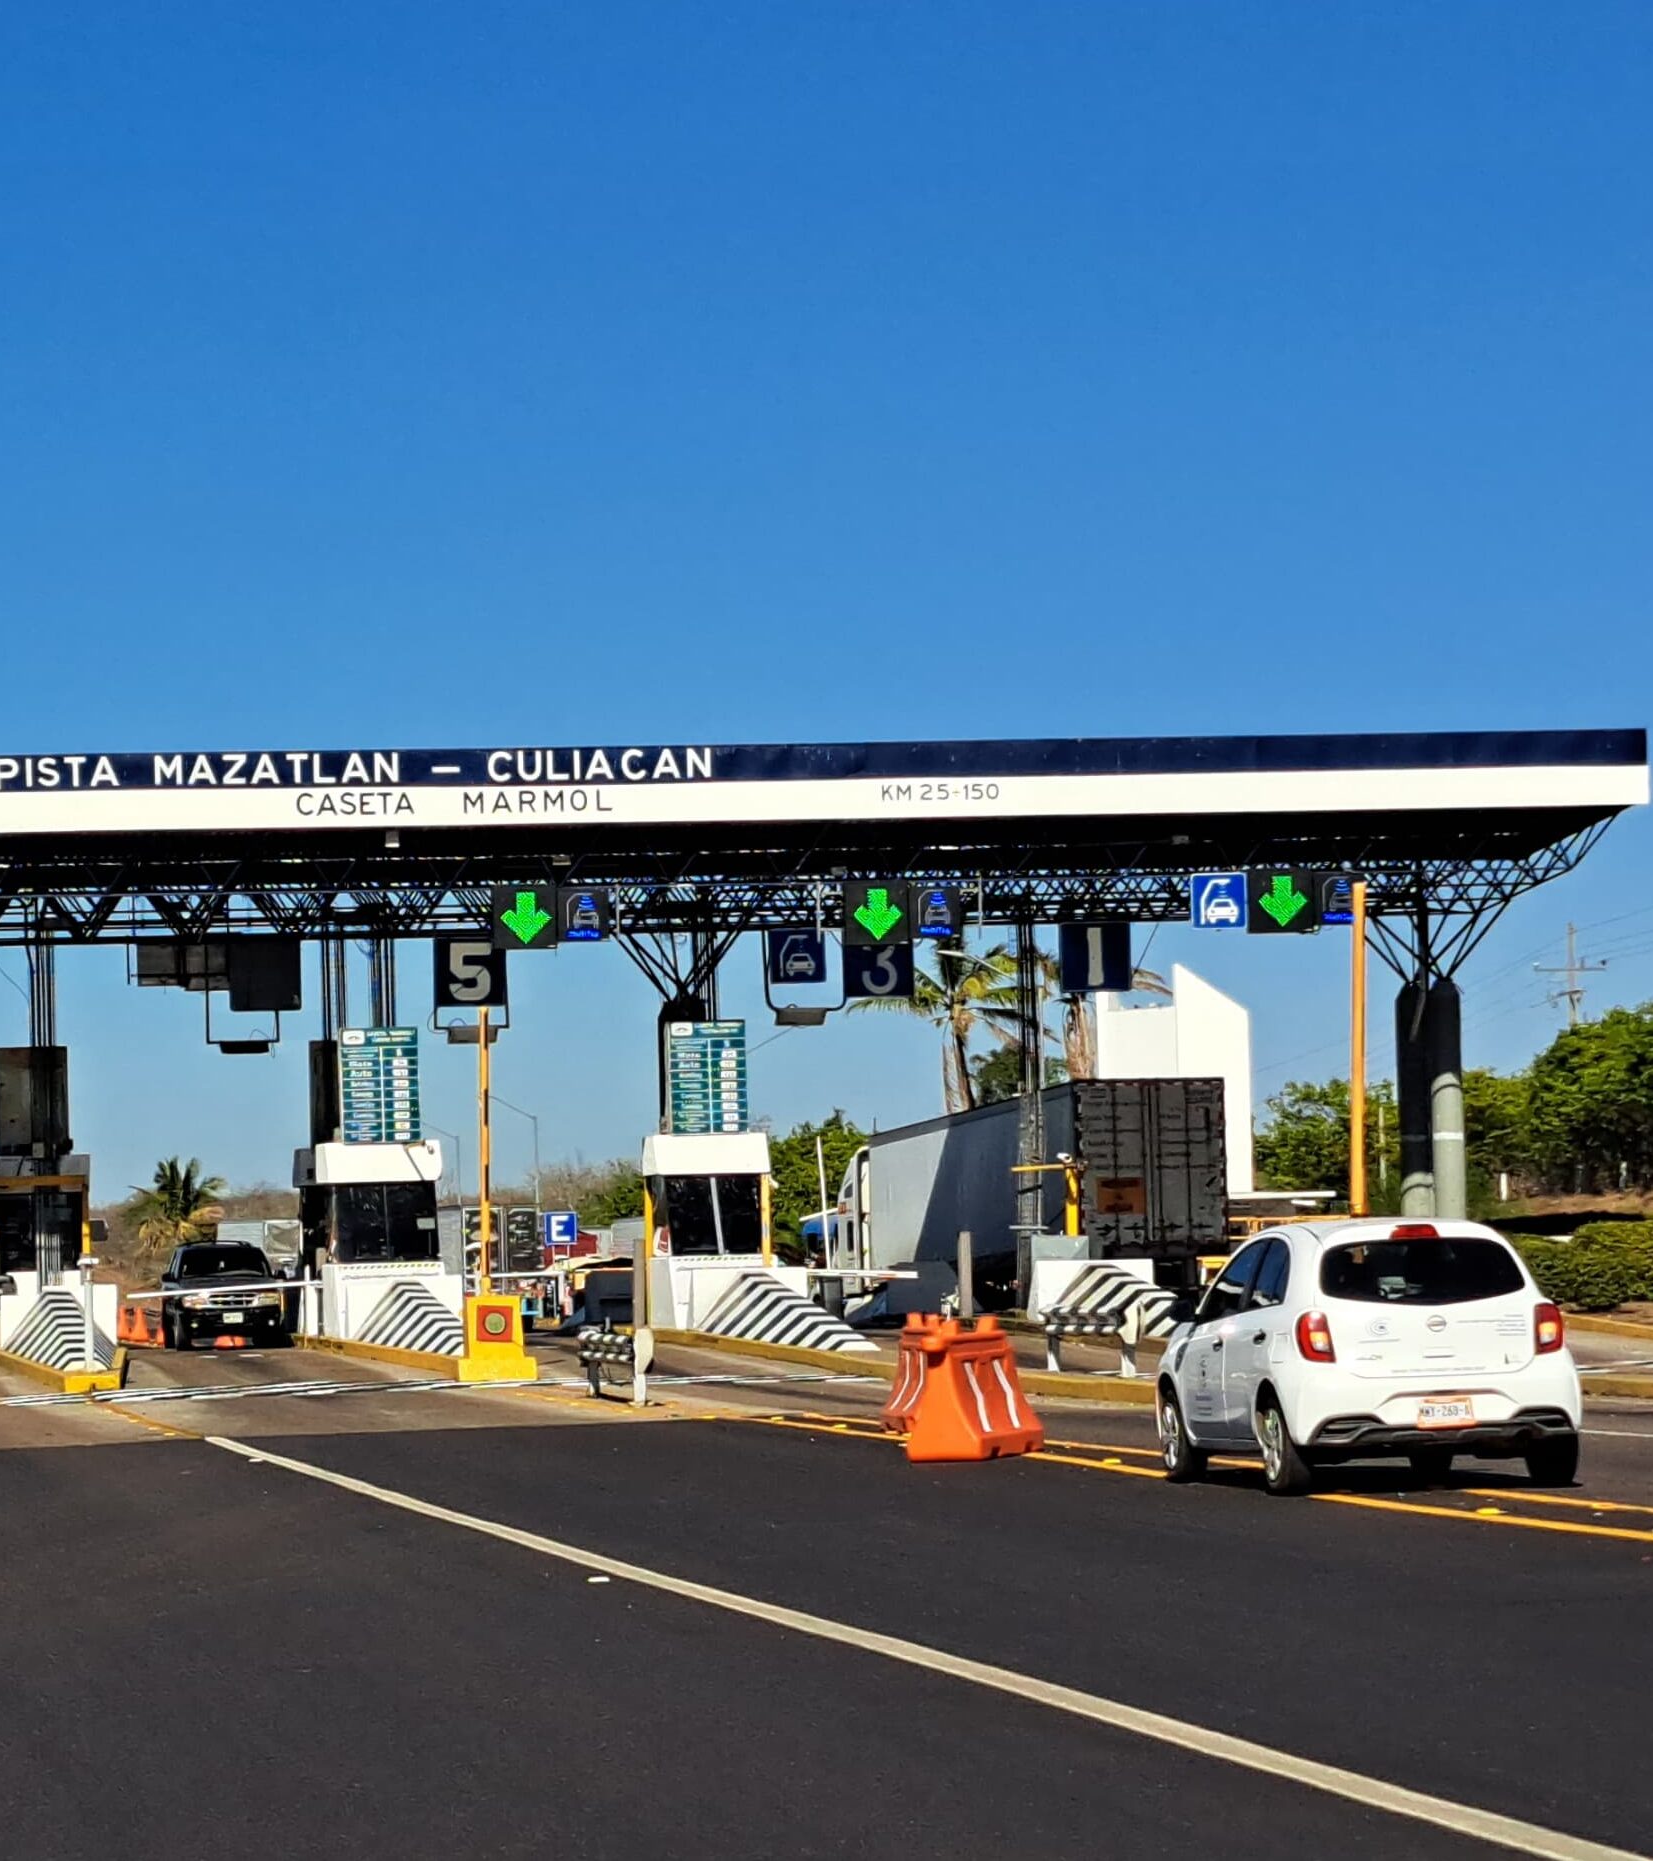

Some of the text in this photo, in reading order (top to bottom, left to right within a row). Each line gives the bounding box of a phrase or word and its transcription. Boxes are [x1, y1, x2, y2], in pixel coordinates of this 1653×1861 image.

[153, 752, 400, 785] MAZATLAN
[487, 748, 712, 782] CULIACAN
[295, 789, 613, 816] CASETA MARMOL
[881, 784, 912, 801] KM
[449, 942, 492, 1001] 5
[862, 945, 898, 994] 3
[1087, 927, 1105, 987] 1
[551, 1215, 572, 1242] E
